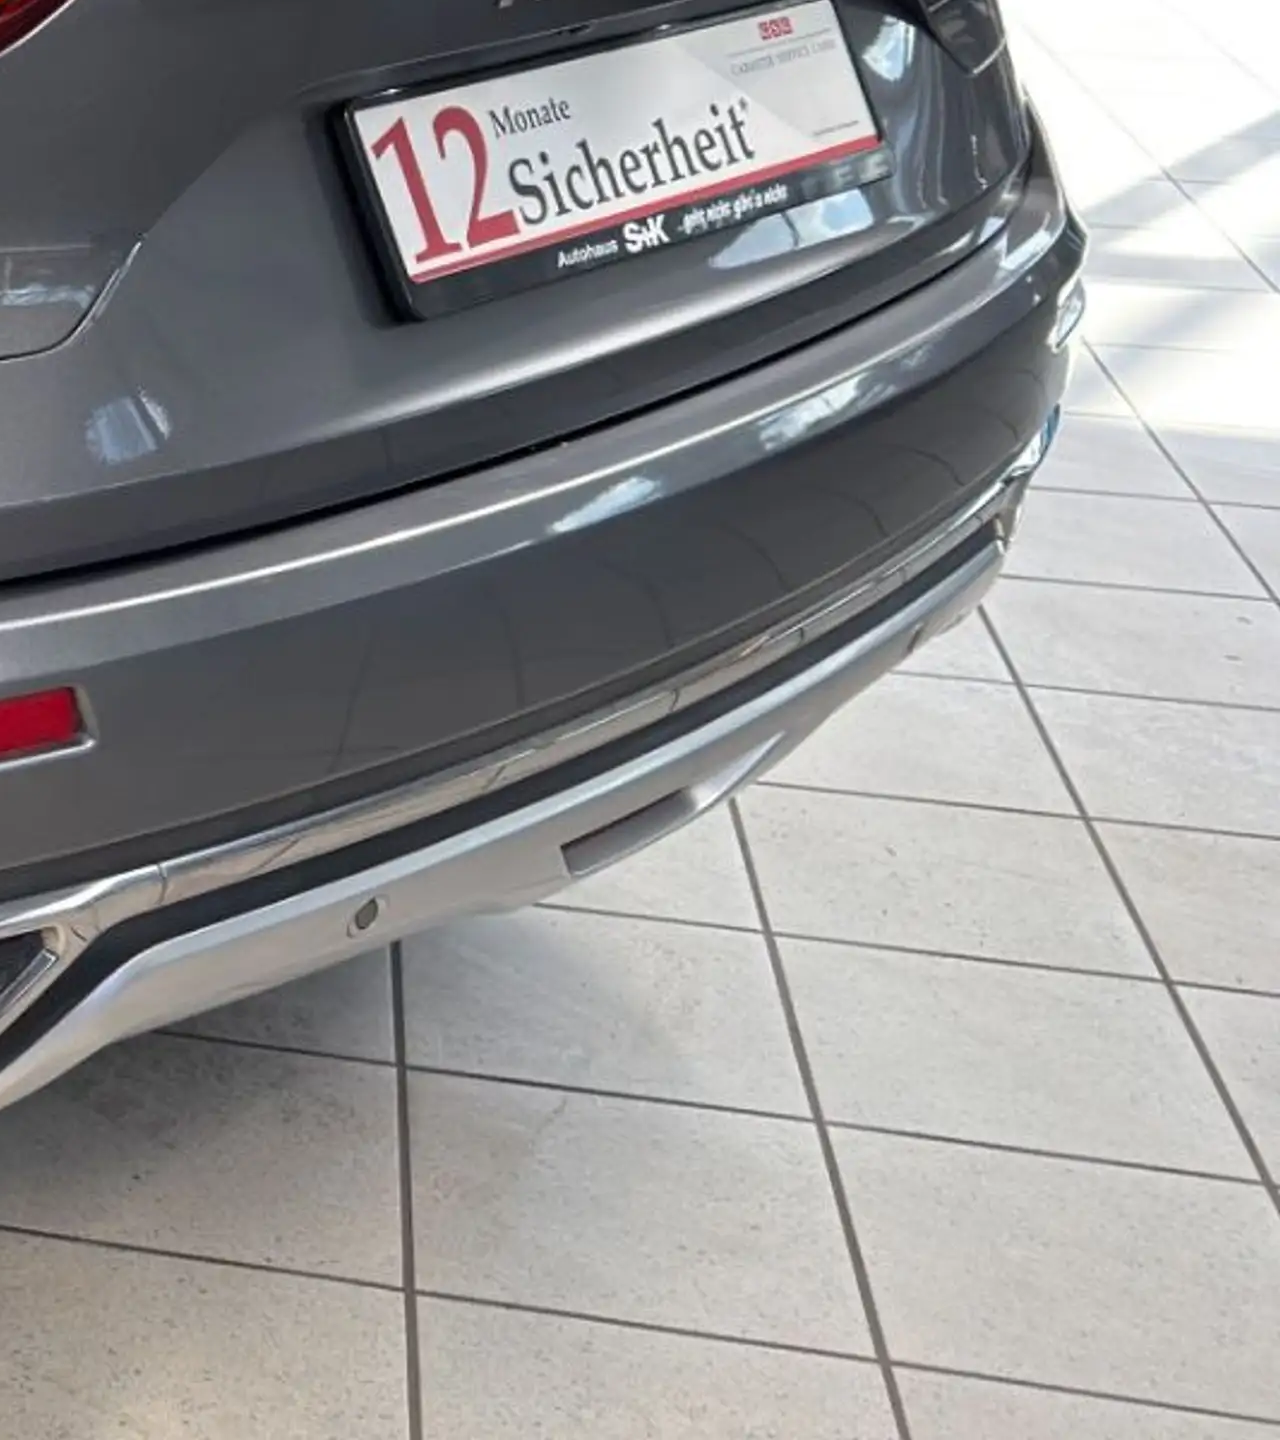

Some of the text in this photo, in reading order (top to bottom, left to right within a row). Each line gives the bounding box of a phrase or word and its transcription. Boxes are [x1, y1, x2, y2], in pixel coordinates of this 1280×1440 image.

[488, 97, 572, 138] Monate
[371, 105, 521, 264] 12
[556, 237, 619, 268] Autohaus
